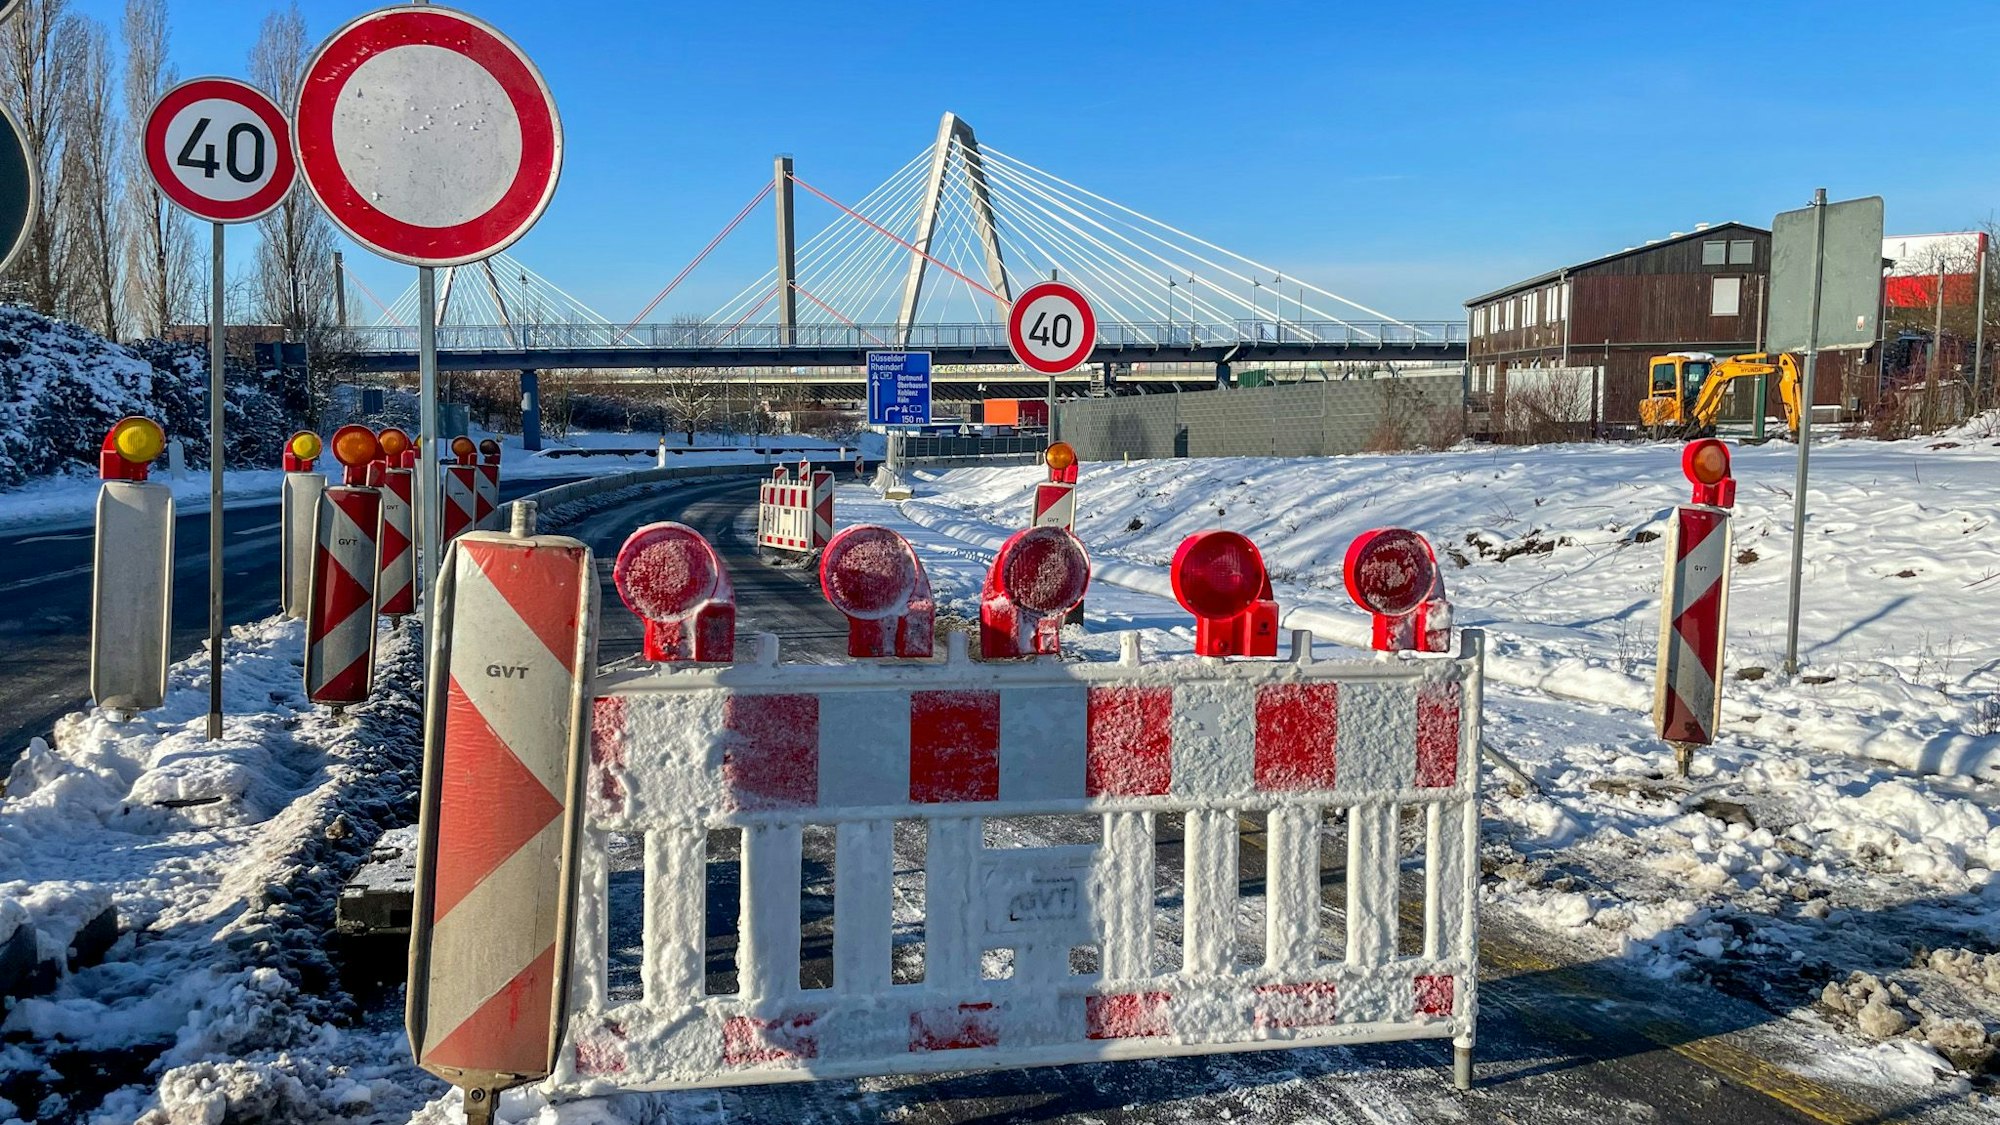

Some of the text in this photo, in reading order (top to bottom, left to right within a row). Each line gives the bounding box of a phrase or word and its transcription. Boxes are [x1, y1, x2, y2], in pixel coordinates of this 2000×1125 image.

[177, 117, 265, 183] 40
[1029, 312, 1072, 348] 40
[870, 354, 906, 362] Düsseldorf
[901, 415, 914, 424] 150
[338, 538, 358, 546] GVT
[486, 664, 530, 680] GVT
